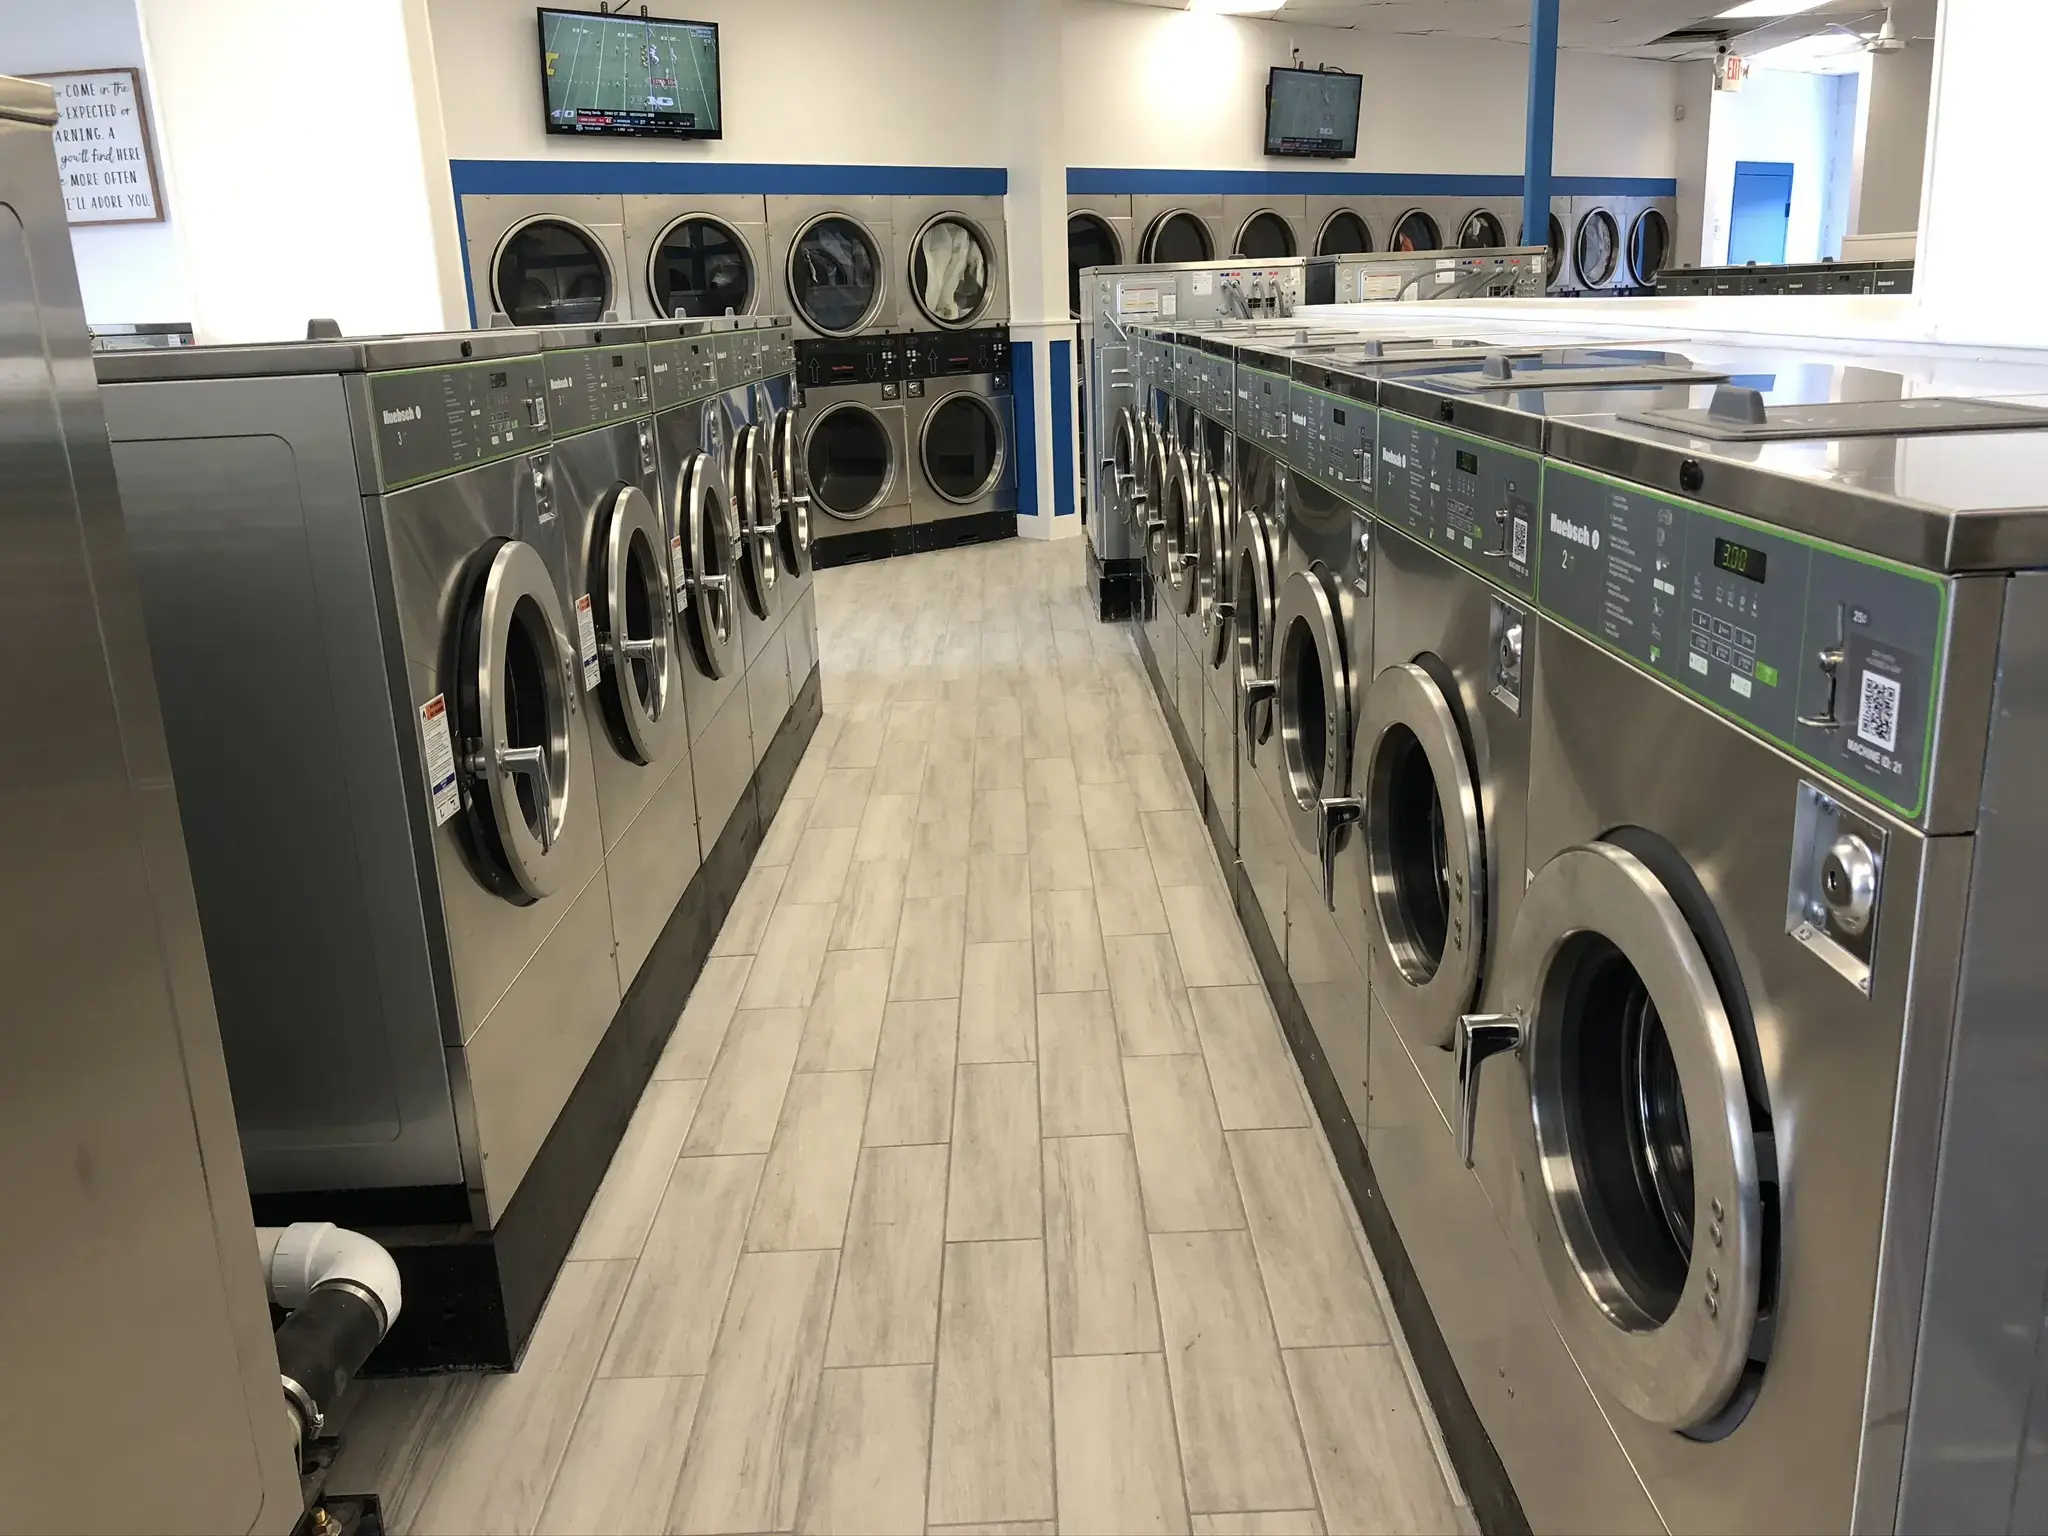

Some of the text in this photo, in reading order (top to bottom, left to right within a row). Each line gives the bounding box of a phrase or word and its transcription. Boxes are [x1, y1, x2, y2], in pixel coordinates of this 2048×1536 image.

[1727, 58, 1742, 80] EXIT
[66, 84, 96, 98] COME
[100, 87, 110, 95] in
[109, 82, 129, 96] the
[66, 104, 117, 120] EXPECTED
[55, 127, 115, 142] ARNING. A
[60, 147, 141, 170] you'll find HERE
[70, 172, 99, 187] MORE
[104, 171, 137, 185] OFTEN
[66, 196, 86, 210] E'LL
[91, 194, 123, 209] ADORE
[382, 406, 415, 425] Huebsch
[1550, 512, 1590, 547] Huebsch
[1561, 549, 1568, 569] 2
[1847, 738, 1881, 765] MACHINE
